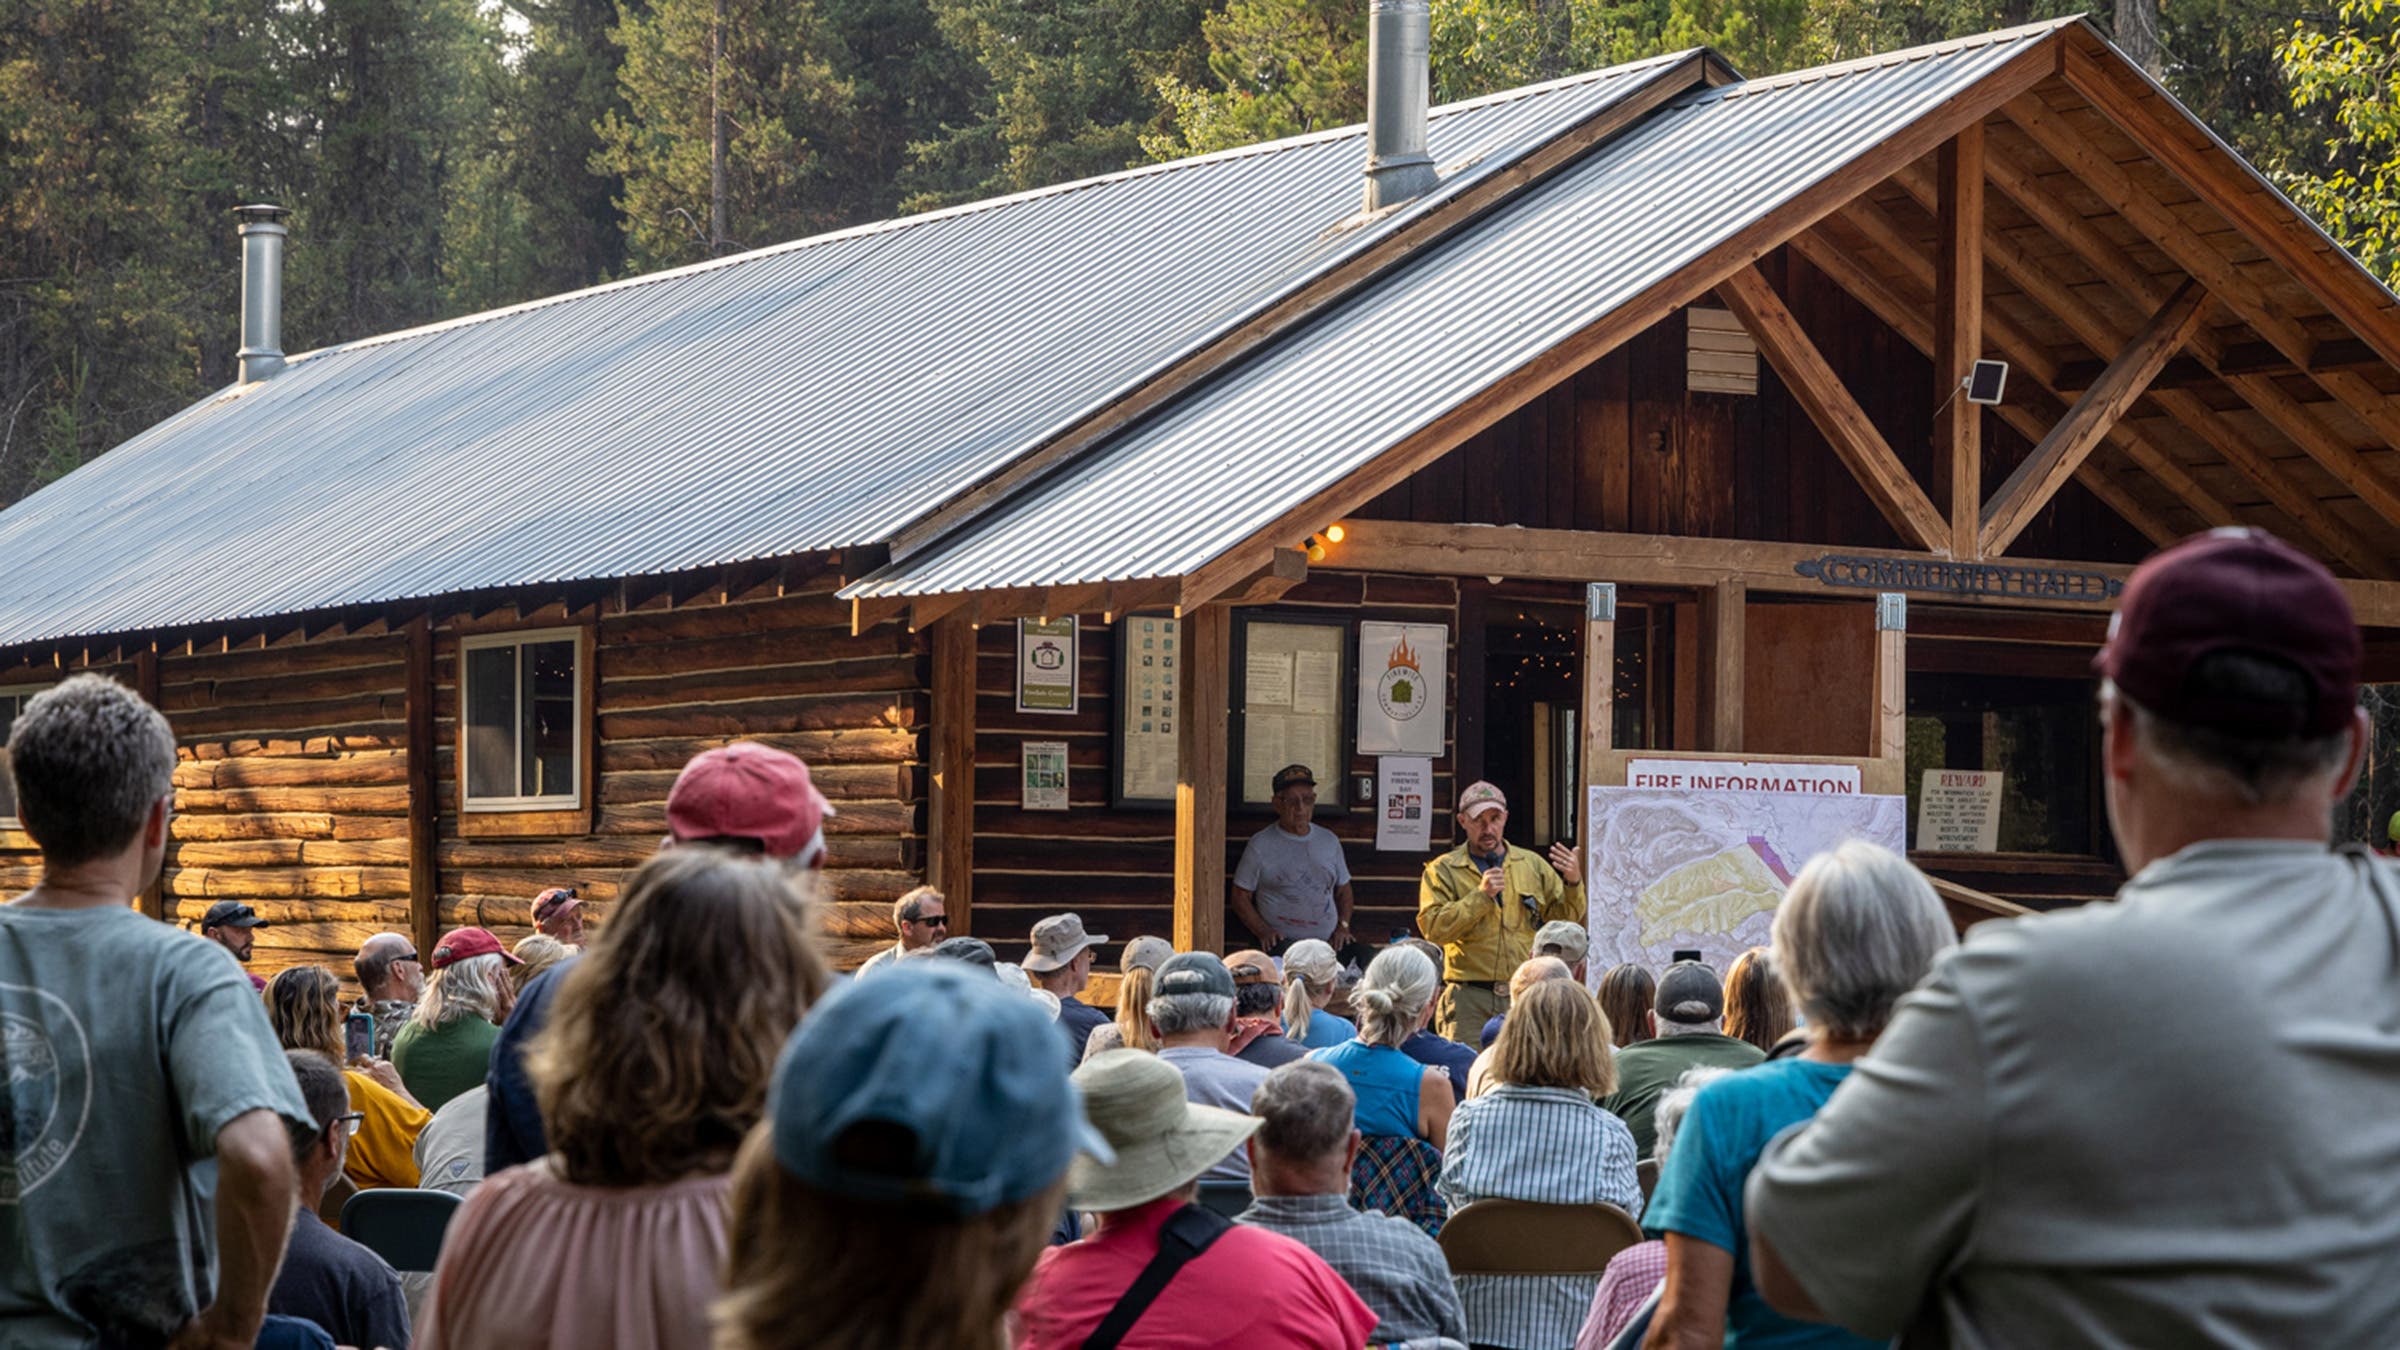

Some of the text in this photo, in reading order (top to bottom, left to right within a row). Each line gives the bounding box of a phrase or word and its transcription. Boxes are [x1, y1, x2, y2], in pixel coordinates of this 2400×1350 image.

[1829, 558, 2101, 597] COMMUNITY HALL
[1690, 776, 1852, 794] INFORMATION
[1940, 774, 1987, 788] REWARD
